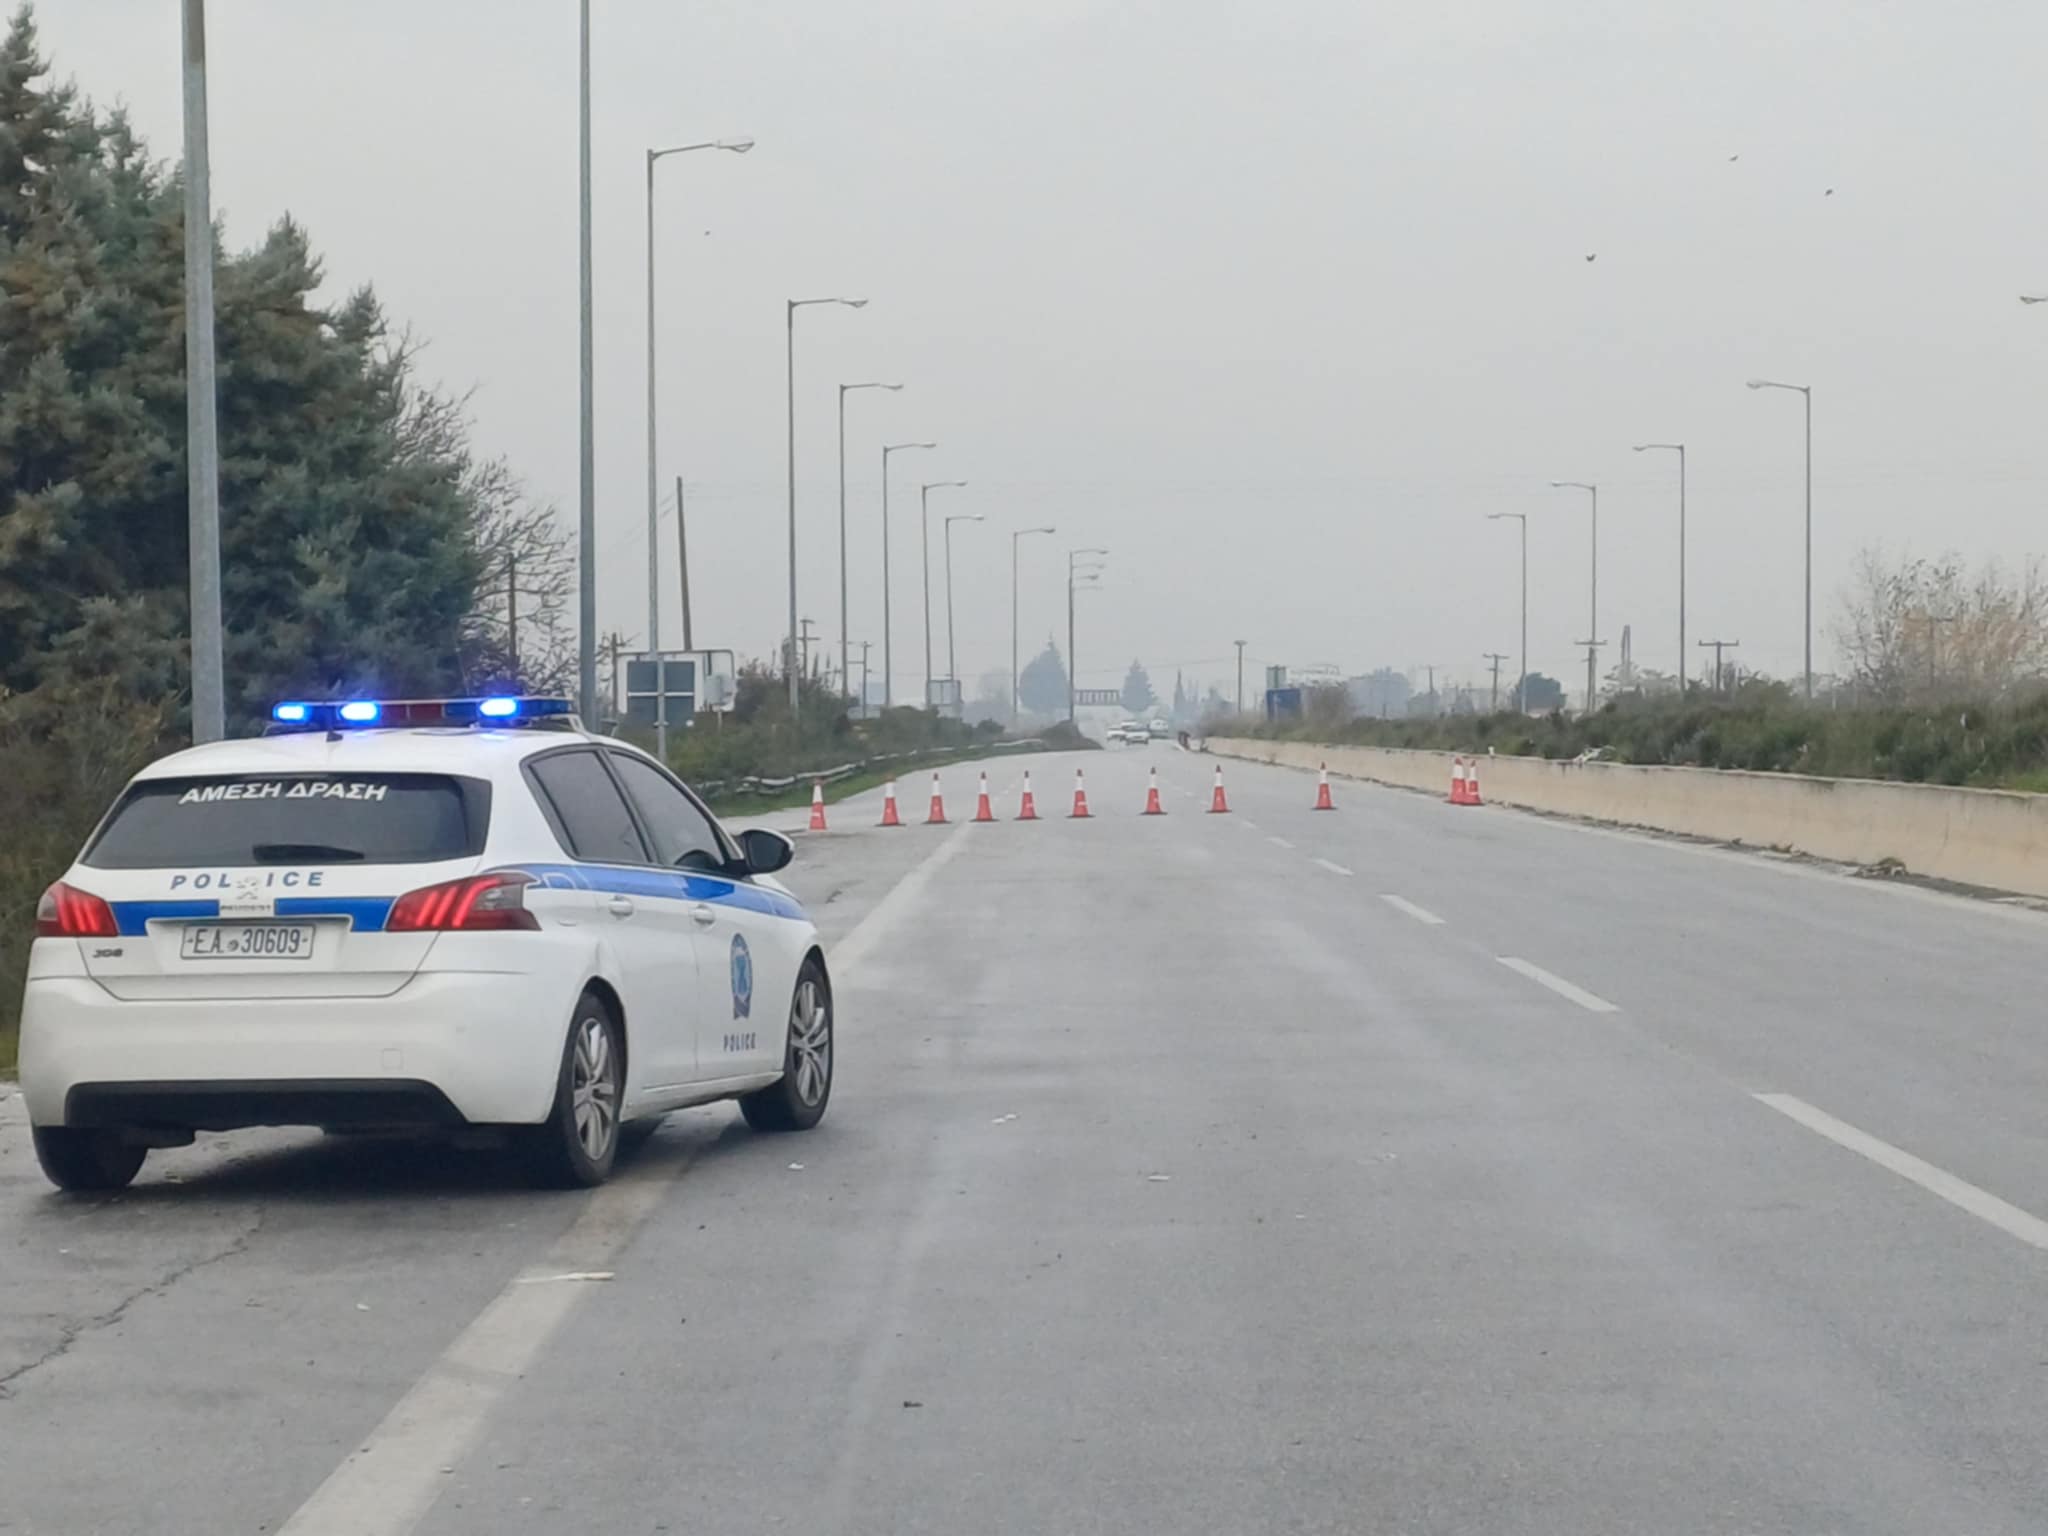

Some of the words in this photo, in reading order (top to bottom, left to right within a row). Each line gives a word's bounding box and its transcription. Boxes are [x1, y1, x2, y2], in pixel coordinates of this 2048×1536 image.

[178, 783, 281, 805] ΑΜΕΣΗ
[286, 782, 388, 801] ΔΡΑΣΗ
[724, 1032, 756, 1052] POLICE
